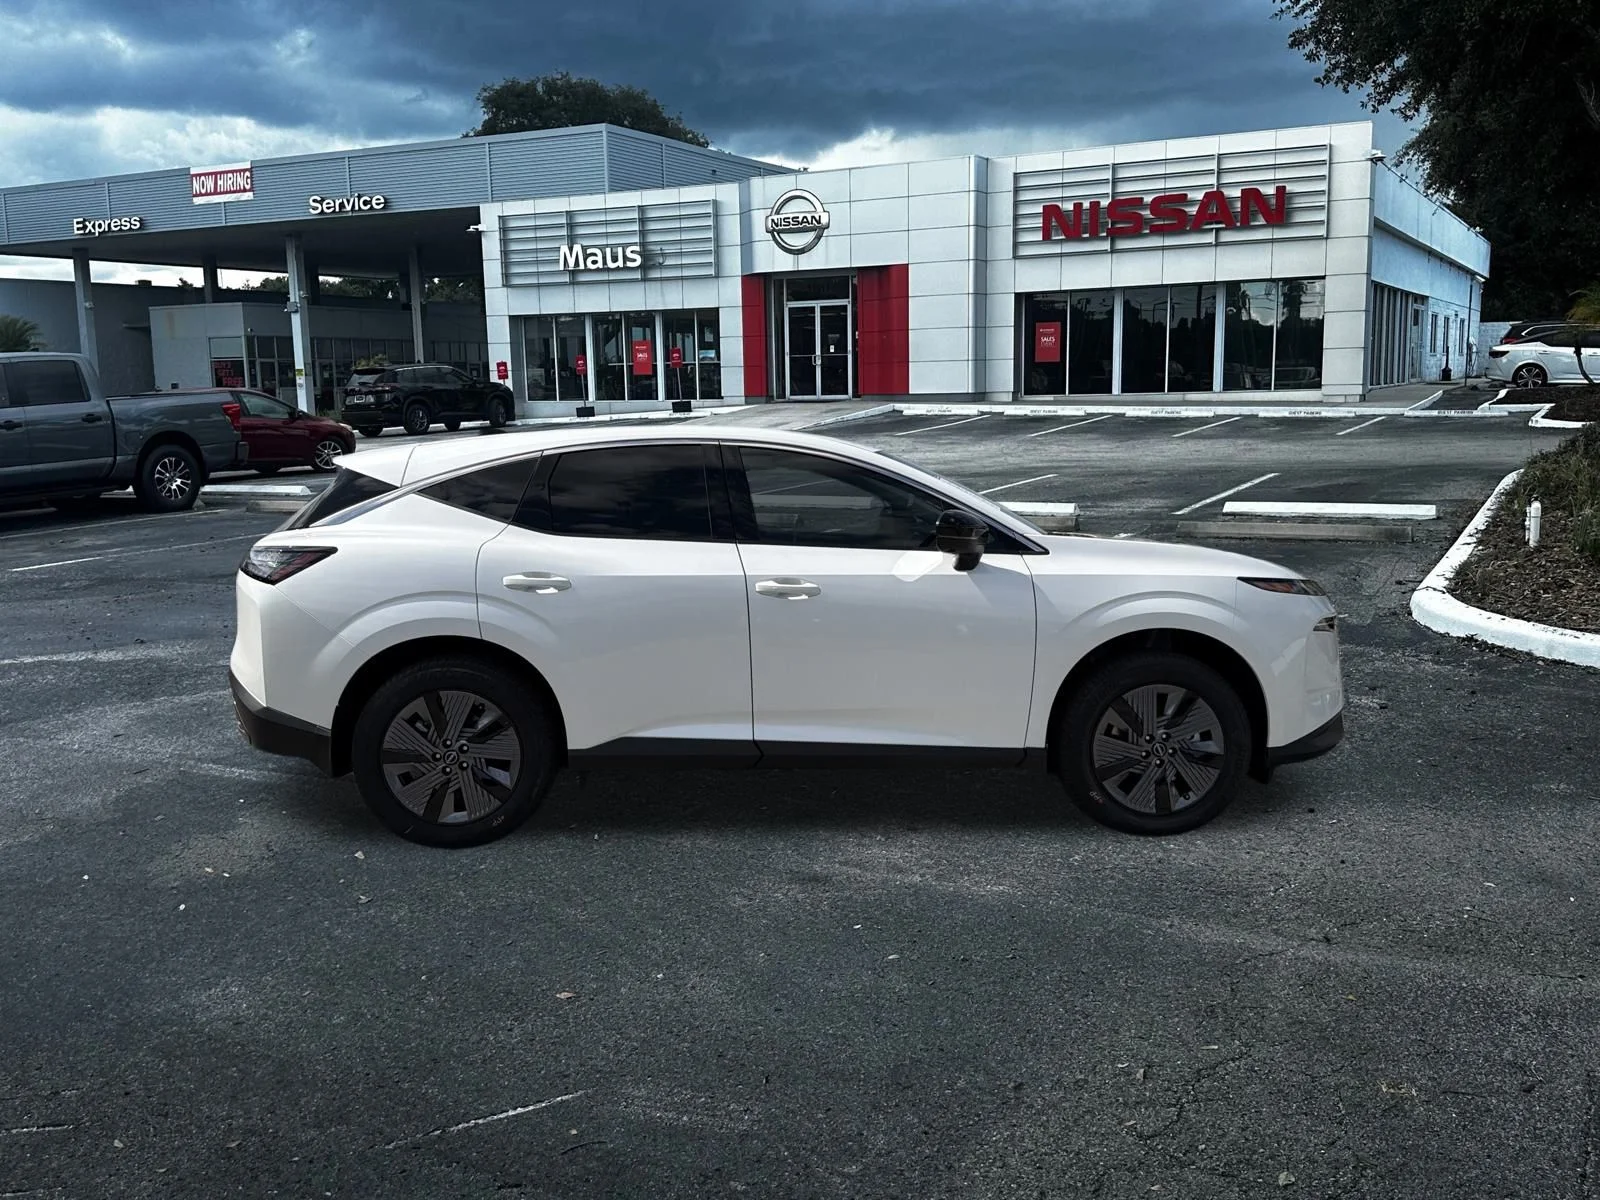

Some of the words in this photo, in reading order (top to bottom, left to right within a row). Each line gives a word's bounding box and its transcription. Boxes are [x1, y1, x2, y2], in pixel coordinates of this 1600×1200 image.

[192, 174, 215, 195] NOW
[217, 171, 251, 193] HIRING
[309, 192, 385, 215] Service
[1042, 185, 1287, 241] NISSAN
[73, 216, 141, 237] Express
[770, 214, 822, 228] NISSAN
[559, 243, 642, 271] Maus
